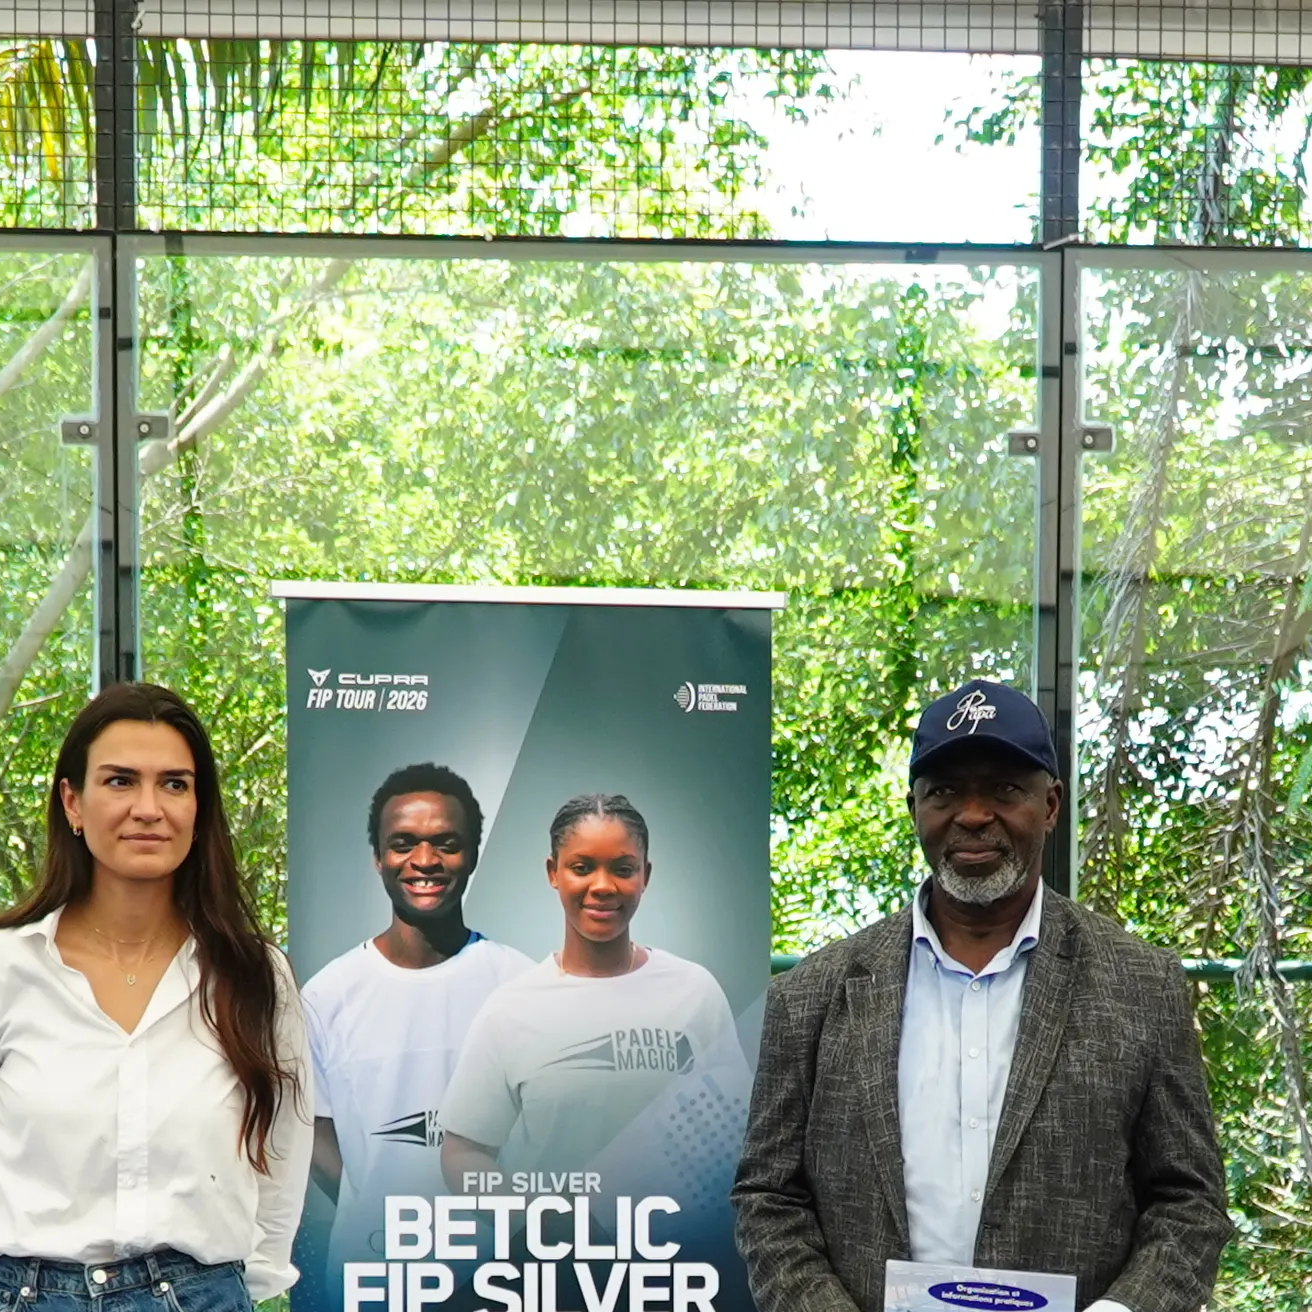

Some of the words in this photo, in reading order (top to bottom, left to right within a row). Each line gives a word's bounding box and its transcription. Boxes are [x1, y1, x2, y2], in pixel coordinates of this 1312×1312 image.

[338, 673, 428, 686] CUPRA
[698, 683, 748, 695] INTERNATIONAL
[306, 688, 333, 709] FIP
[336, 688, 376, 709] TOUR
[386, 690, 428, 711] 2026
[614, 1028, 675, 1050] PADEL
[616, 1049, 677, 1072] MAGIC
[462, 1172, 502, 1194] FIP
[511, 1172, 602, 1194] SILVER
[384, 1195, 682, 1261] BETCLIC
